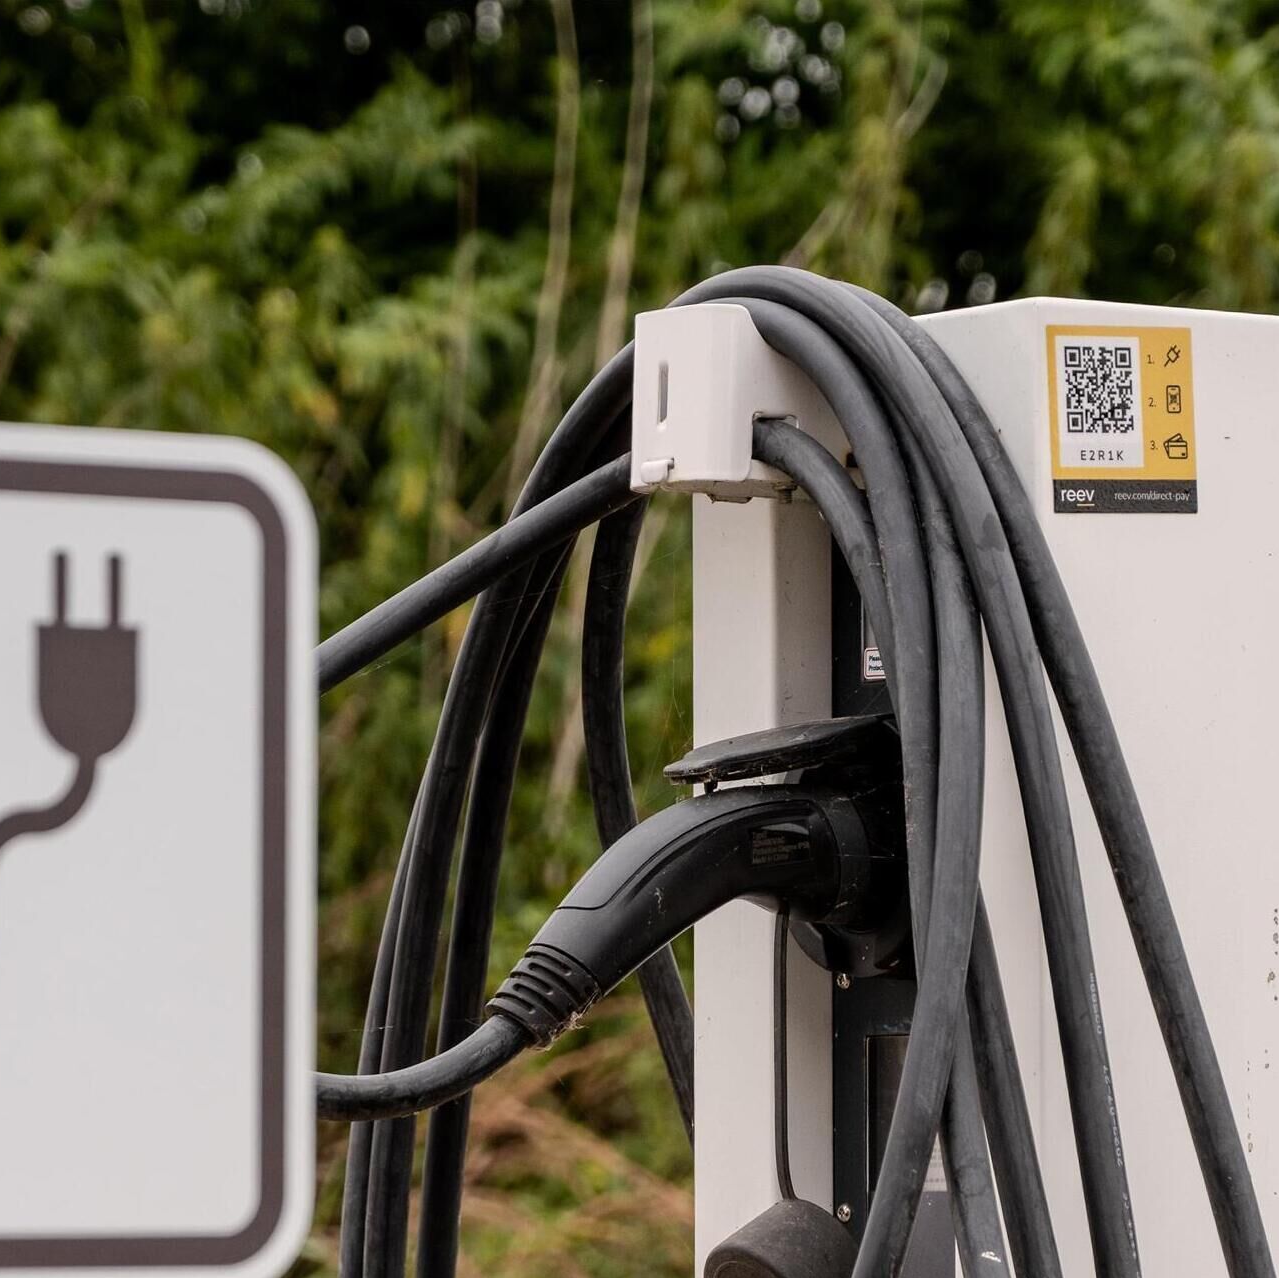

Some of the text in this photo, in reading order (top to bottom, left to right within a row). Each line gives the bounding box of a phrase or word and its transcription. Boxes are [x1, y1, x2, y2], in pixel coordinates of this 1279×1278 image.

[1147, 354, 1155, 364] 1.
[1148, 397, 1157, 407] 2.
[1150, 440, 1158, 450] 3.
[1080, 450, 1124, 461] E2R1K
[1060, 489, 1095, 502] reev
[1114, 491, 1190, 502] reev.com/direct-pay
